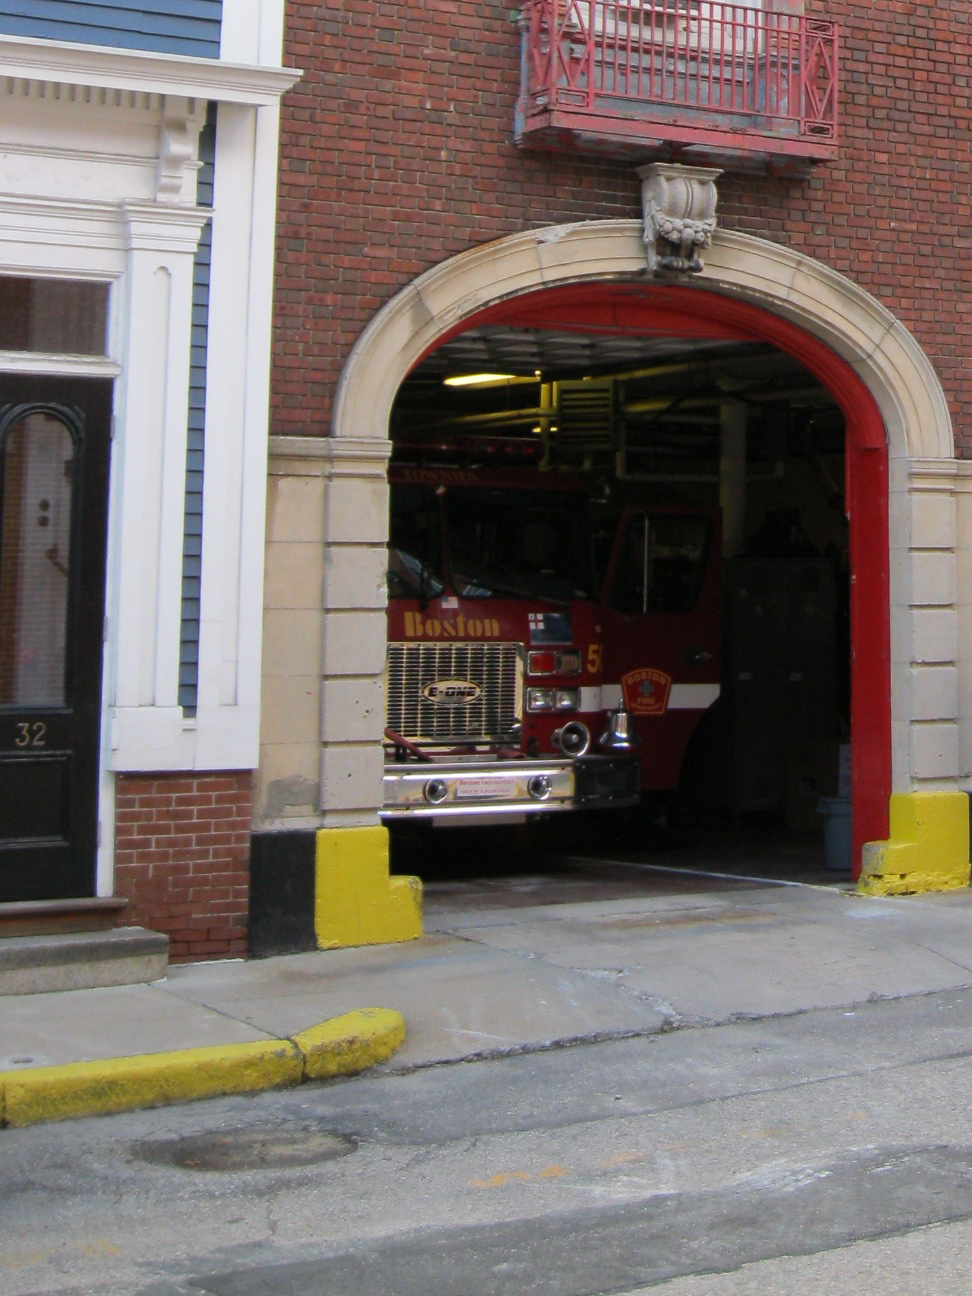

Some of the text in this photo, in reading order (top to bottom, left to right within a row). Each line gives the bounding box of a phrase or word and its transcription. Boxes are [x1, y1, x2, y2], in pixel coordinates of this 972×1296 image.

[404, 611, 501, 637] Boston
[587, 644, 603, 673] 5
[627, 671, 666, 685] BOSTON
[428, 687, 477, 697] E-ONE
[637, 697, 656, 705] FIRE
[15, 722, 46, 746] 32
